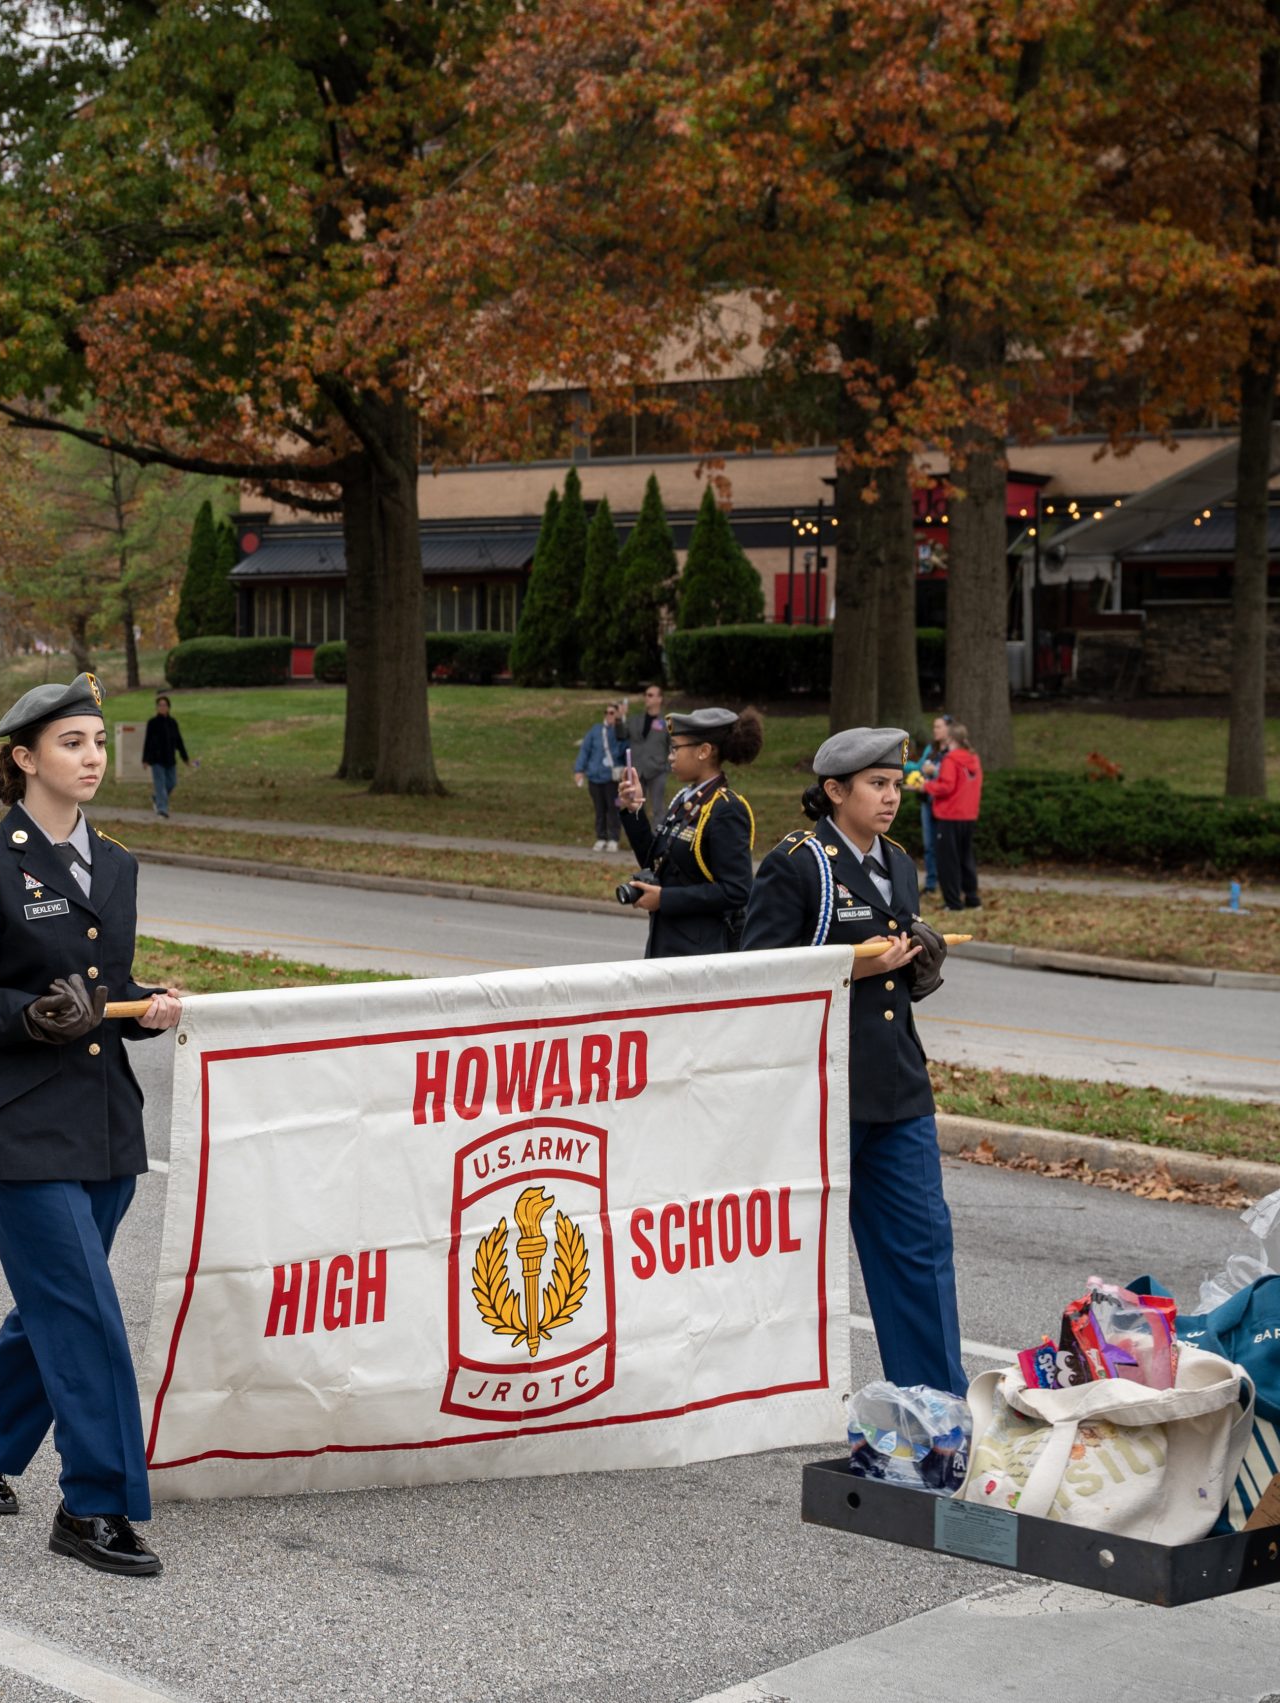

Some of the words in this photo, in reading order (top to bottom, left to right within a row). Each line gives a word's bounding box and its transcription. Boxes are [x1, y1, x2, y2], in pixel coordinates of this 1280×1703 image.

[413, 1030, 648, 1125] HOWARD
[473, 1145, 516, 1179] U.S.
[521, 1136, 591, 1164] ARMY
[264, 1249, 388, 1337] HIGH
[630, 1187, 801, 1280] SCHOOL
[468, 1365, 589, 1403] JROTC
